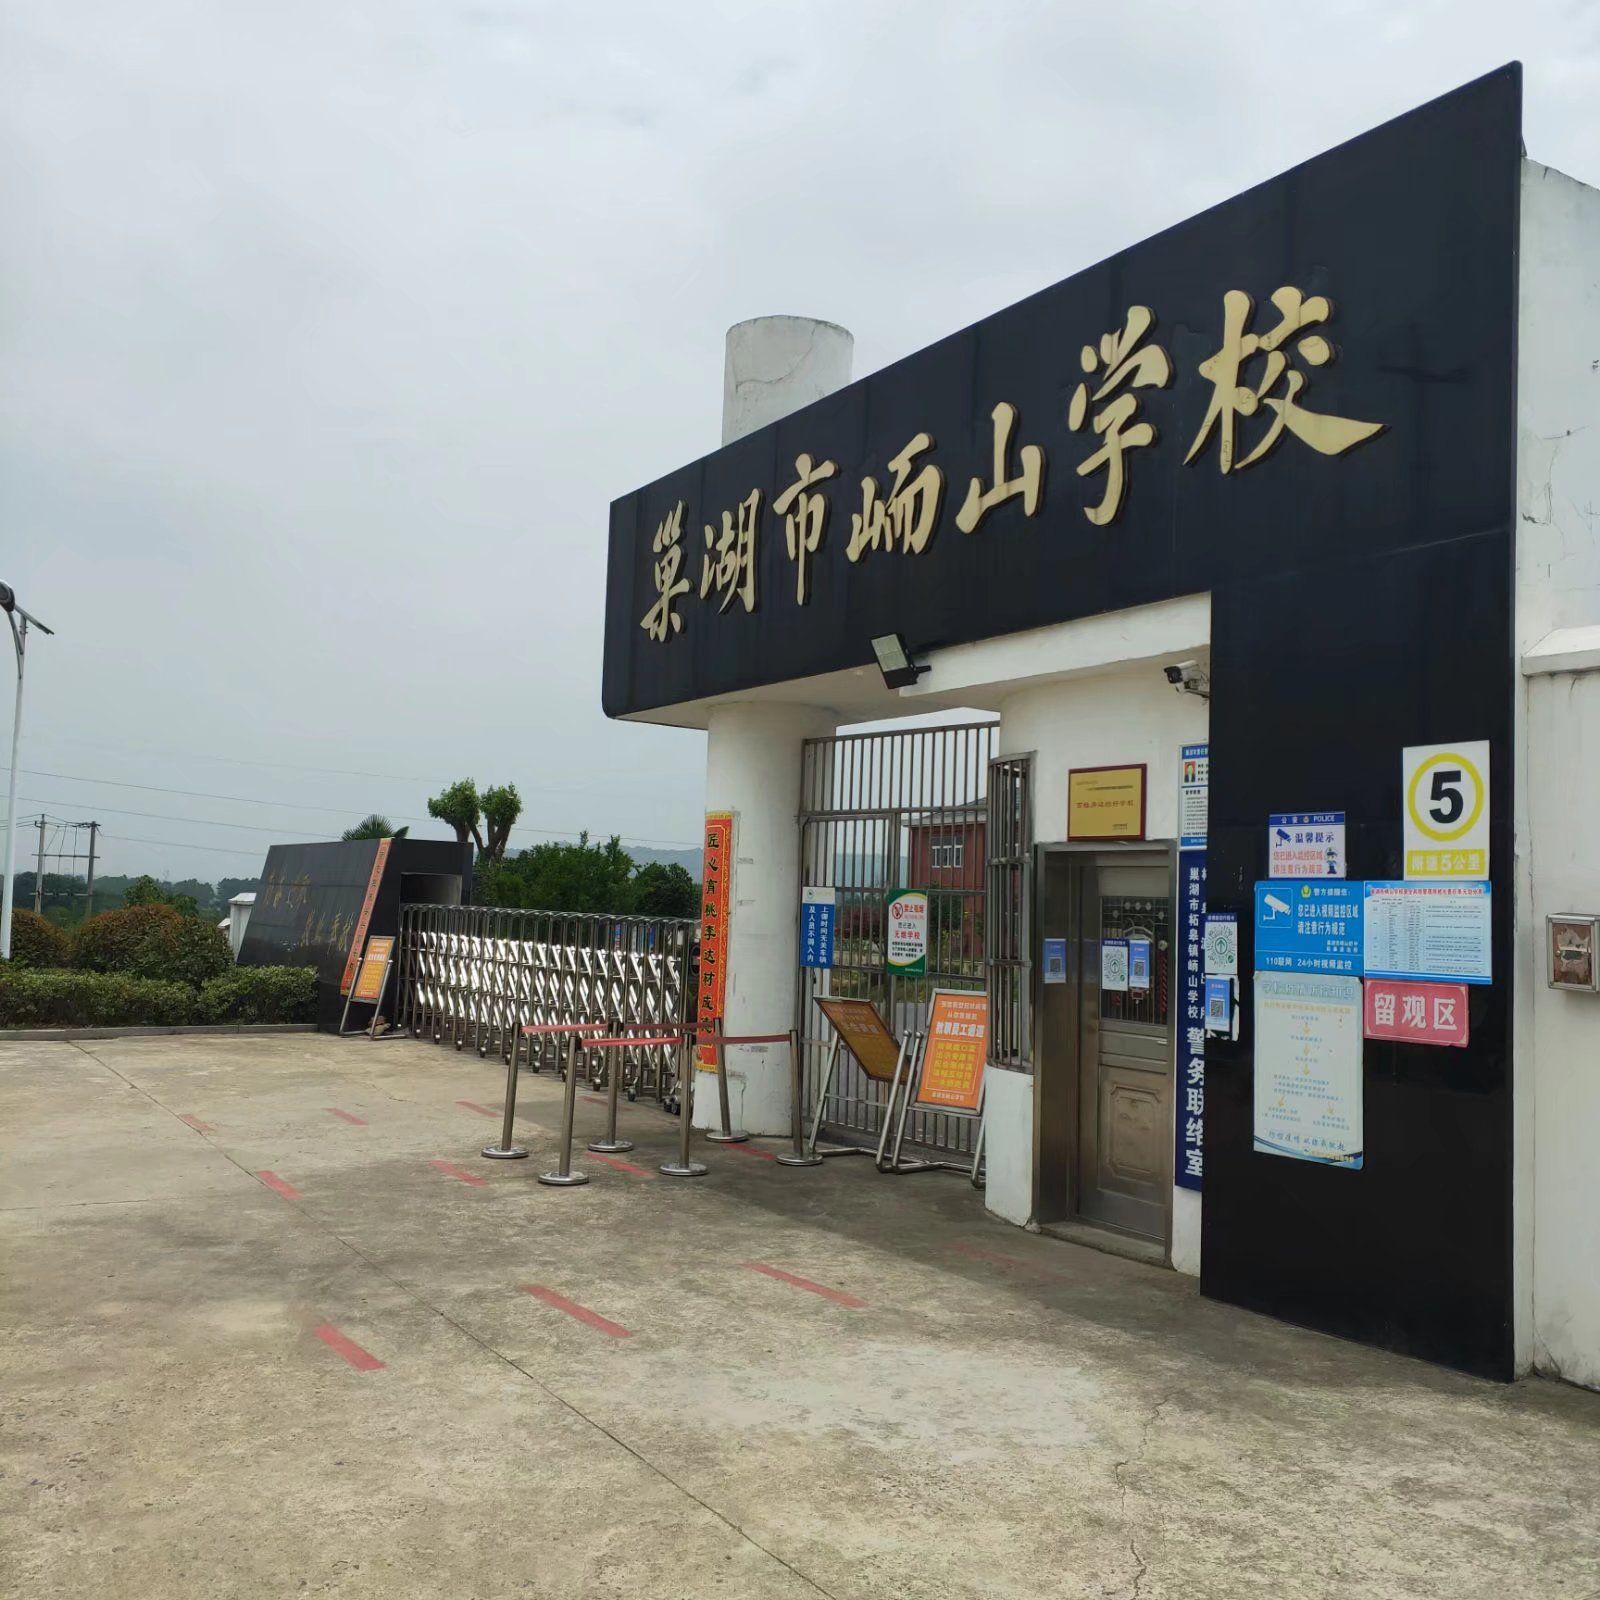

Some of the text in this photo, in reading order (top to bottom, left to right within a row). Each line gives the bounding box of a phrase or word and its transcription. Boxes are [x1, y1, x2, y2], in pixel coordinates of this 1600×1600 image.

[1429, 770, 1464, 823] 5
[1313, 814, 1335, 823] POLICE
[1294, 831, 1335, 845] 温馨提示
[1411, 854, 1481, 872] 限速5公里
[1297, 904, 1359, 919] 您已进入视频监控区域
[807, 906, 816, 962] 及人员不得入内
[894, 931, 921, 940] 无烟学校
[1297, 921, 1346, 936] 请注意行为规范
[1266, 957, 1353, 970] 110联网 24小时视频监控
[1374, 992, 1458, 1031] 留观区
[935, 1021, 985, 1038] 教职员工通道
[1185, 1027, 1205, 1177] 警务联络室
